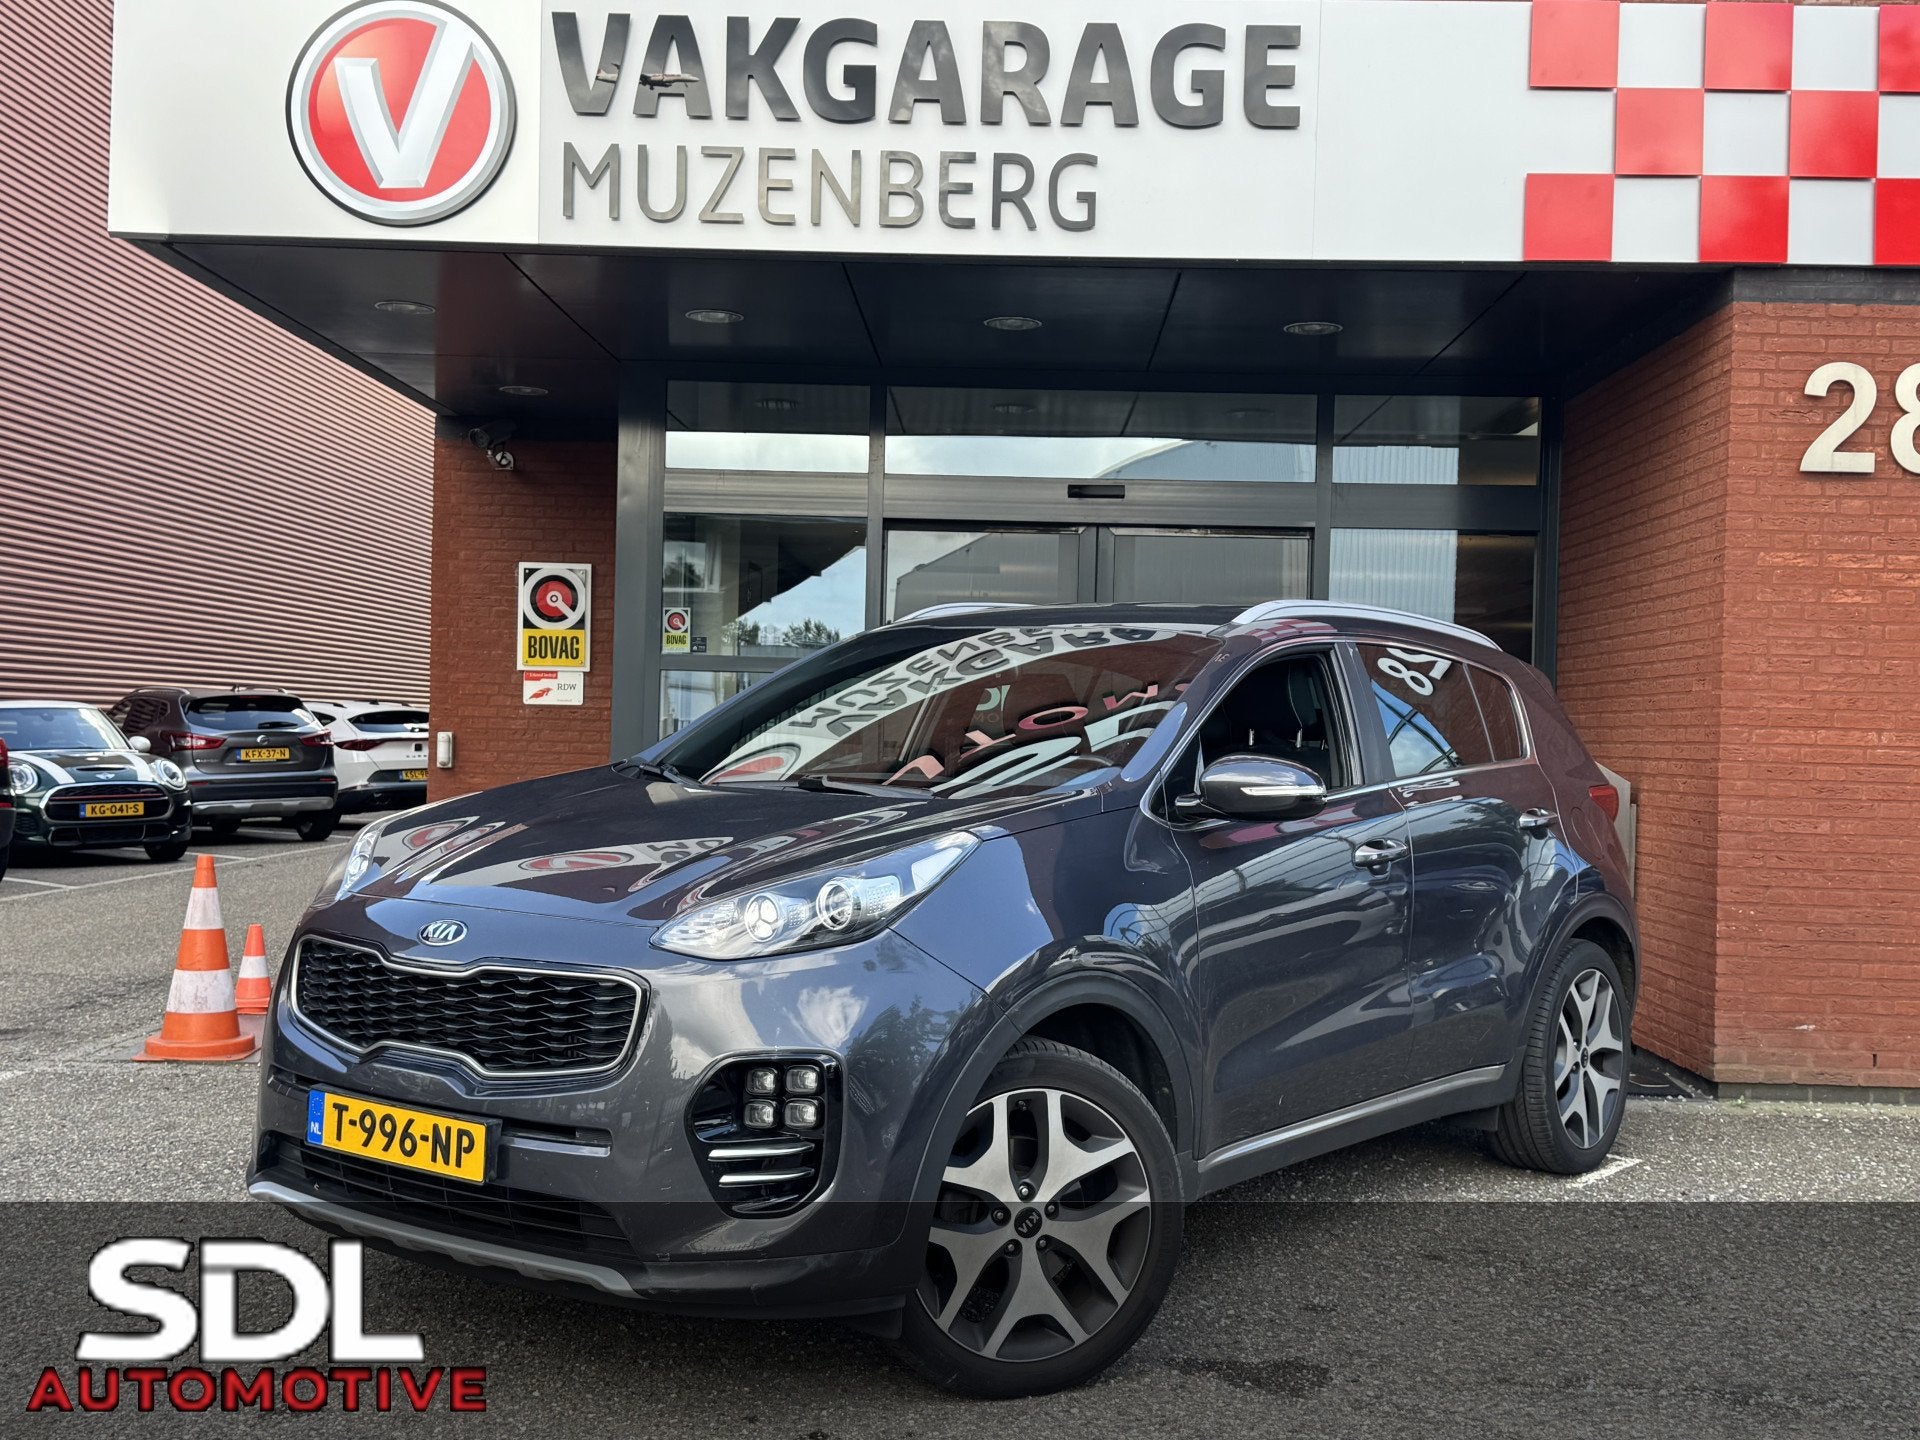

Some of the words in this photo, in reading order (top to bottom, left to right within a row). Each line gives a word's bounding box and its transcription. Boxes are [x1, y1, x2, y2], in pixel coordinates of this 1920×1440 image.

[552, 11, 1301, 129] VAKGARAGE
[562, 142, 1098, 232] MUZENBERG
[527, 635, 580, 660] BOVAG
[666, 634, 687, 645] BOVAG
[557, 683, 577, 691] RDW
[245, 749, 286, 759] KFX-37-N
[90, 803, 140, 816] KG-041-S
[422, 922, 458, 941] KIA
[310, 1120, 322, 1136] NL
[332, 1102, 475, 1169] T-996-NP
